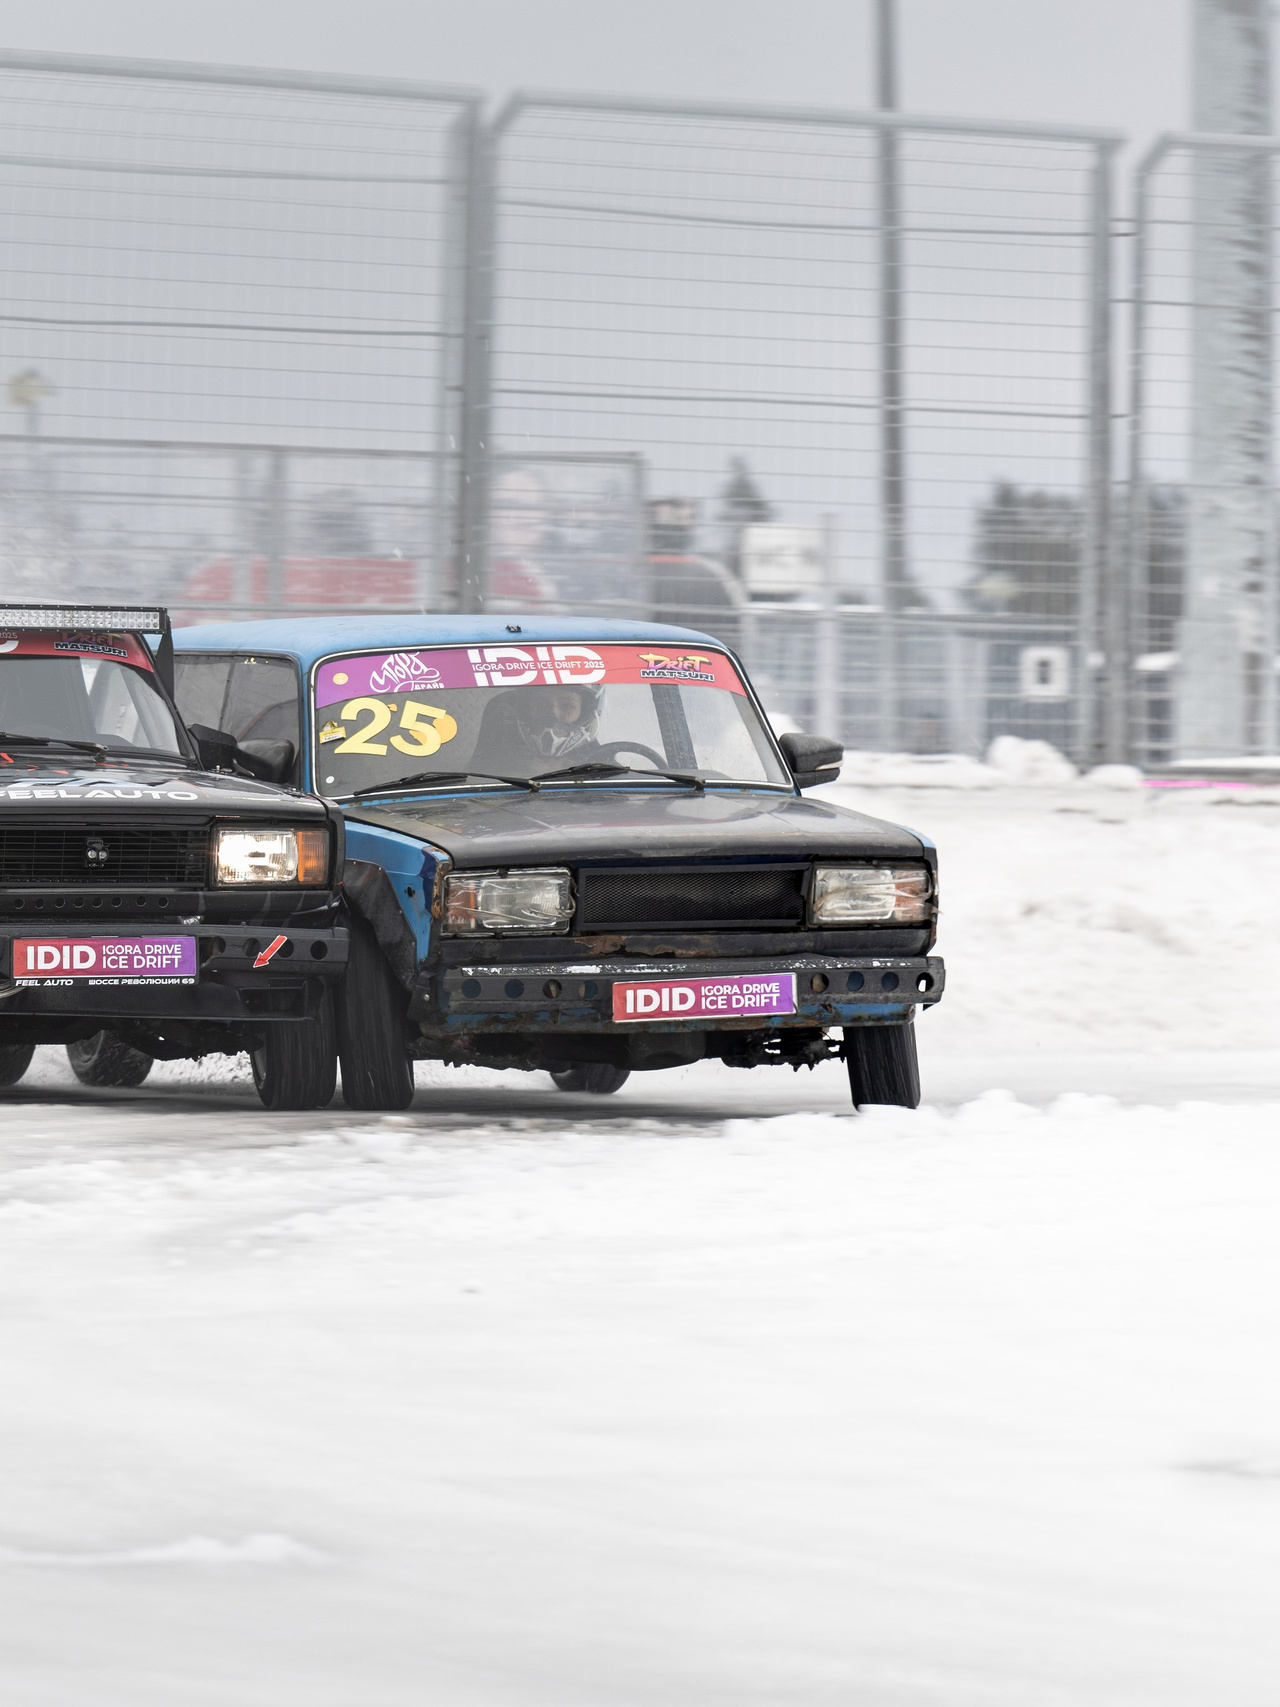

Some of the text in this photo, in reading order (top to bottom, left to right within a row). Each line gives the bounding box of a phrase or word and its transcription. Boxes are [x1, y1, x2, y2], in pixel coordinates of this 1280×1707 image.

[53, 642, 128, 657] MATSURI
[467, 646, 607, 687] IDID
[472, 660, 605, 672] IGORA DRIVE ICE DRIFT 2025
[640, 669, 715, 682] MATSURI
[414, 682, 445, 690] ДРАЙВ
[334, 697, 442, 757] 25
[102, 944, 182, 955] IGORA DRIVE
[26, 945, 97, 970] IDID
[102, 955, 182, 969] ICE DRIFT
[88, 978, 120, 986] ШОССЕ
[701, 983, 780, 996] IGORA DRIVE
[625, 987, 696, 1014] IDID
[701, 993, 781, 1010] ICE DRIFT
